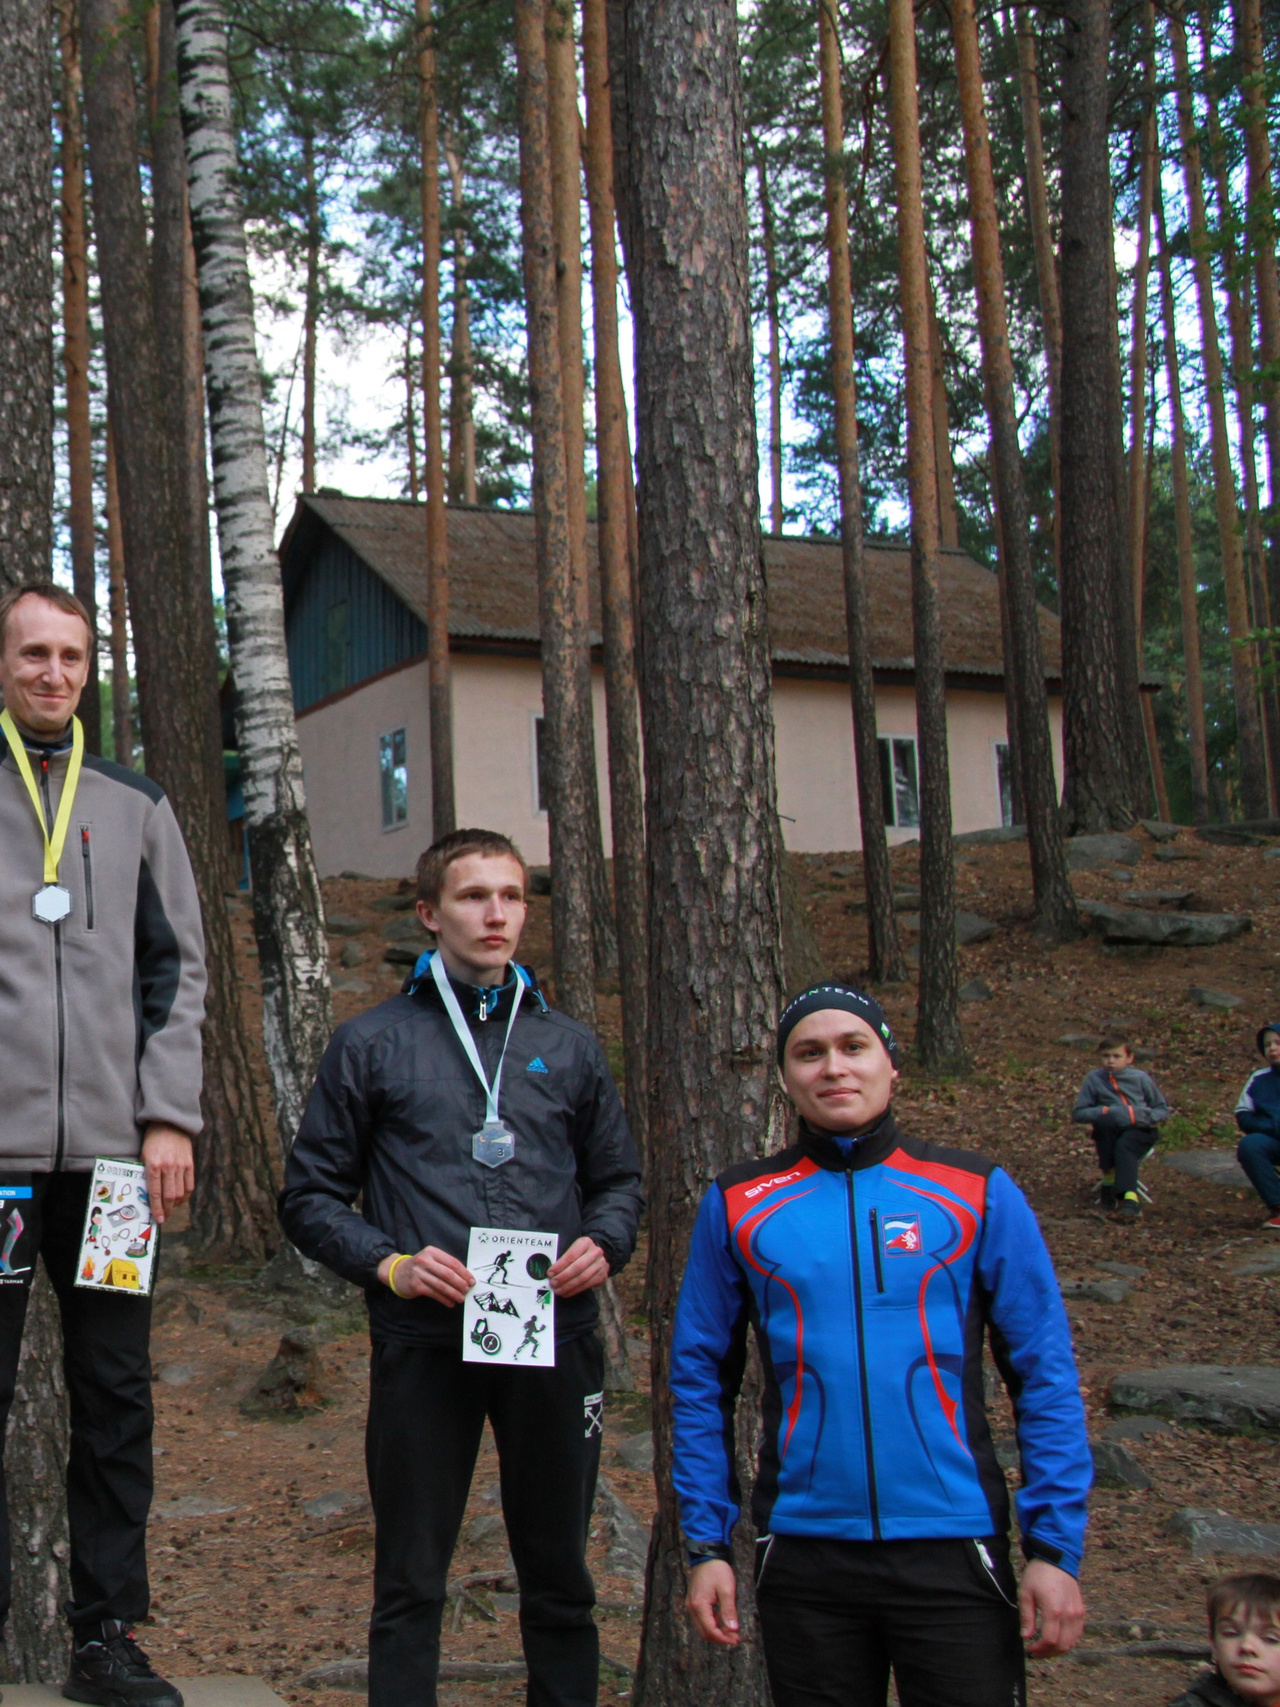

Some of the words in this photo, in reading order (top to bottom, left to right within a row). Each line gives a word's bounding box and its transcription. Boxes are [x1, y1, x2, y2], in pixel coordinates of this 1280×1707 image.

[497, 1147, 505, 1158] 3
[107, 1166, 146, 1179] ORIENTE
[491, 1235, 552, 1247] ORIENTEAM
